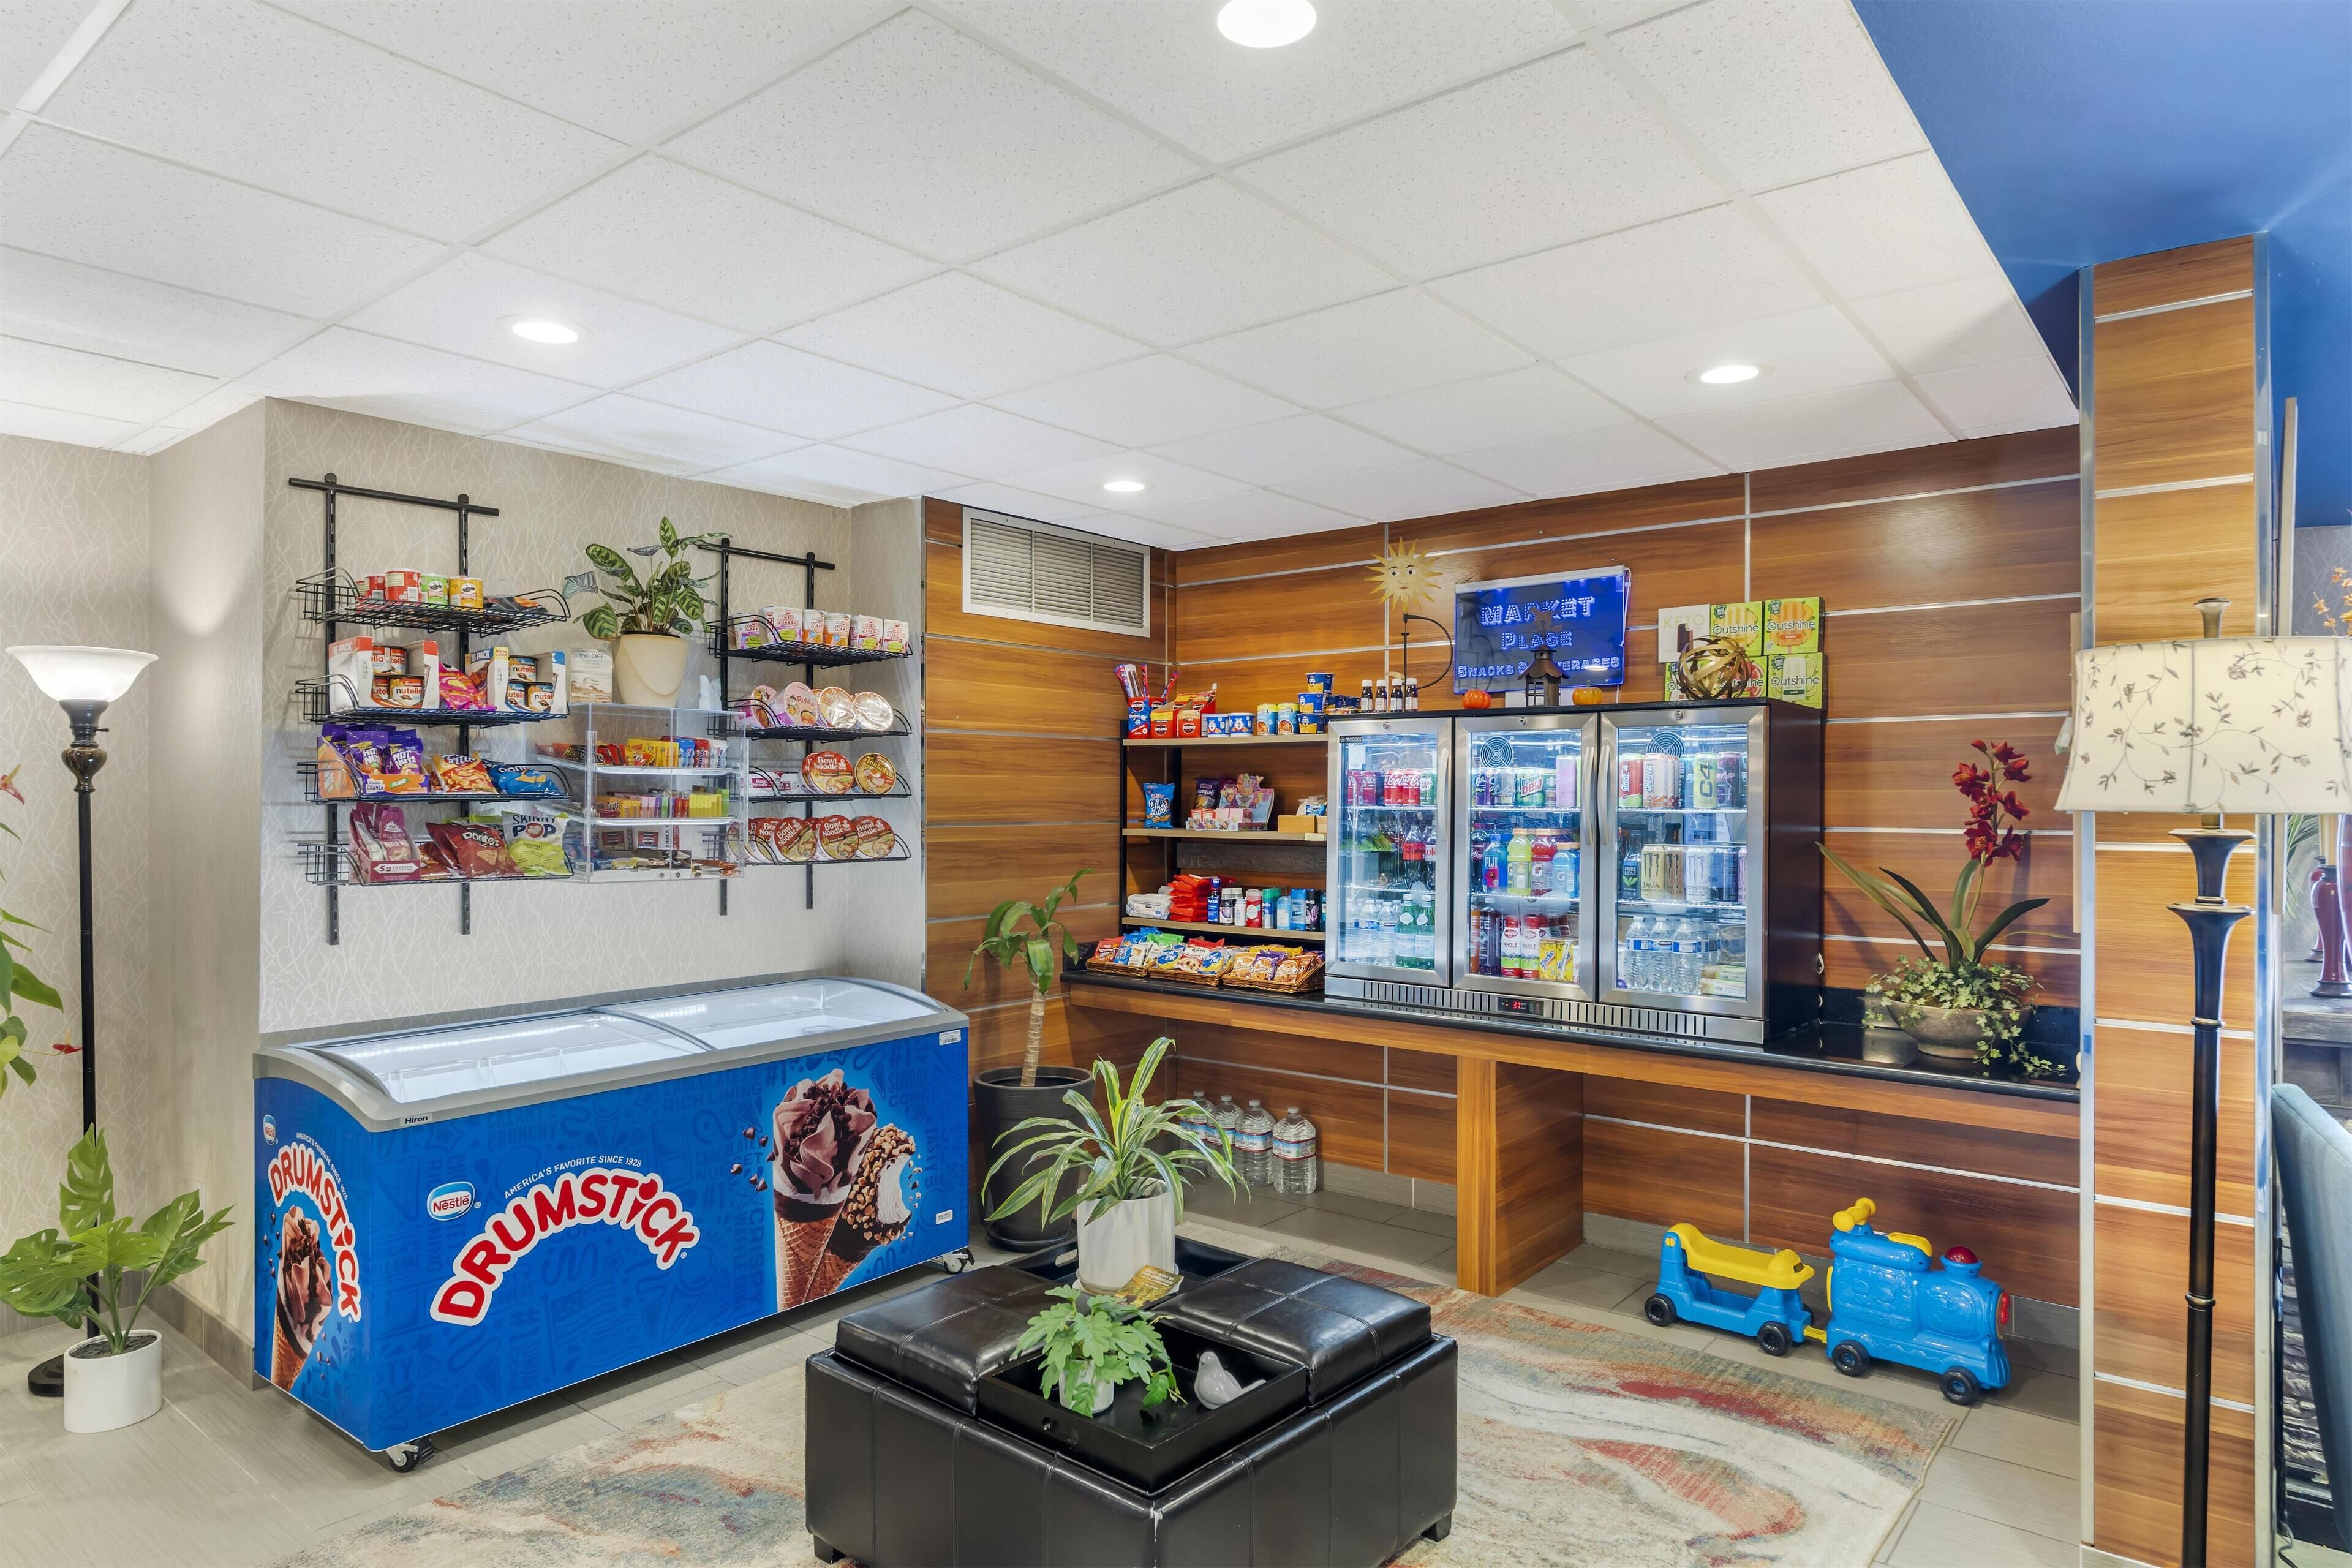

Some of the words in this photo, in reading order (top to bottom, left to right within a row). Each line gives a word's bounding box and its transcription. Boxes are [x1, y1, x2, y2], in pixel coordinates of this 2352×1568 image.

[1481, 596, 1595, 626] MARKET
[1713, 624, 1759, 635] Outshine
[1767, 619, 1815, 631] Outshine
[1502, 631, 1572, 650] PLACE
[477, 650, 490, 660] PACK
[1457, 665, 1514, 678] SNACKS
[1558, 657, 1620, 671] VERAGES
[1771, 676, 1819, 686] Outshine
[396, 686, 423, 695] nutella
[1700, 763, 1713, 797] C4
[1149, 799, 1166, 809] Chips
[513, 815, 556, 824] SKINNY
[824, 821, 842, 831] Bowl
[856, 821, 875, 832] Bowl
[513, 823, 556, 838] POP
[777, 823, 793, 839] Bowl
[778, 828, 797, 847] Noodle
[822, 827, 844, 837] Noodle
[462, 832, 500, 848] Doritos
[1485, 858, 1497, 867] FIJI
[1557, 872, 1566, 881] G
[889, 1066, 930, 1093] SUNDAE
[664, 1094, 704, 1114] RICH
[707, 1080, 763, 1106] LINING
[889, 1089, 930, 1107] CONE
[490, 1121, 559, 1152] CRUNCHY
[296, 1132, 315, 1146] AMERICA'S
[314, 1142, 331, 1166] FAVORITE
[330, 1164, 341, 1185] SINCE
[504, 1167, 552, 1199] AMERICA'S
[554, 1156, 596, 1173] FAVORITE
[598, 1155, 624, 1165] SINCE
[625, 1157, 642, 1167] 1928
[433, 1195, 469, 1212] Nestlé
[270, 1147, 359, 1317] DRUMSTICK
[437, 1174, 695, 1319] DRUMSTICK
[748, 1207, 765, 1305] CRISPY
